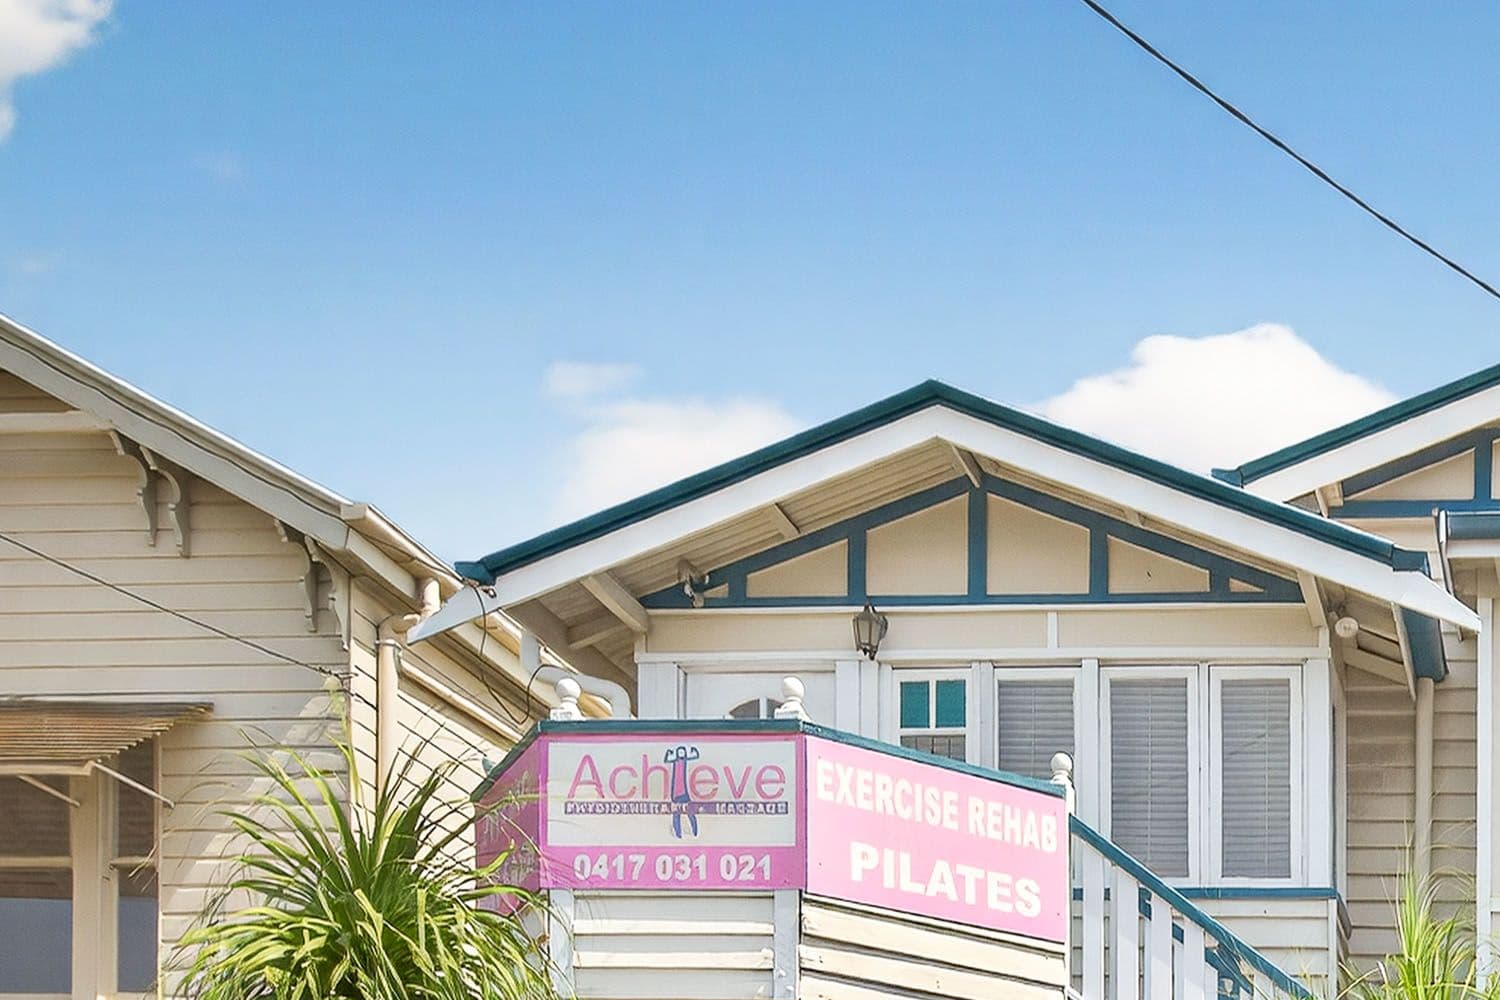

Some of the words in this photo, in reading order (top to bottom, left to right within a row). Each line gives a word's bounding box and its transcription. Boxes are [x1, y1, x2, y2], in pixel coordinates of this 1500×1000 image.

[816, 758, 959, 831] EXERCISE
[967, 795, 1058, 854] REHAB
[573, 853, 646, 882] 0417
[655, 853, 707, 882] 031
[719, 853, 772, 882] 021
[849, 840, 1042, 919] PILATES
